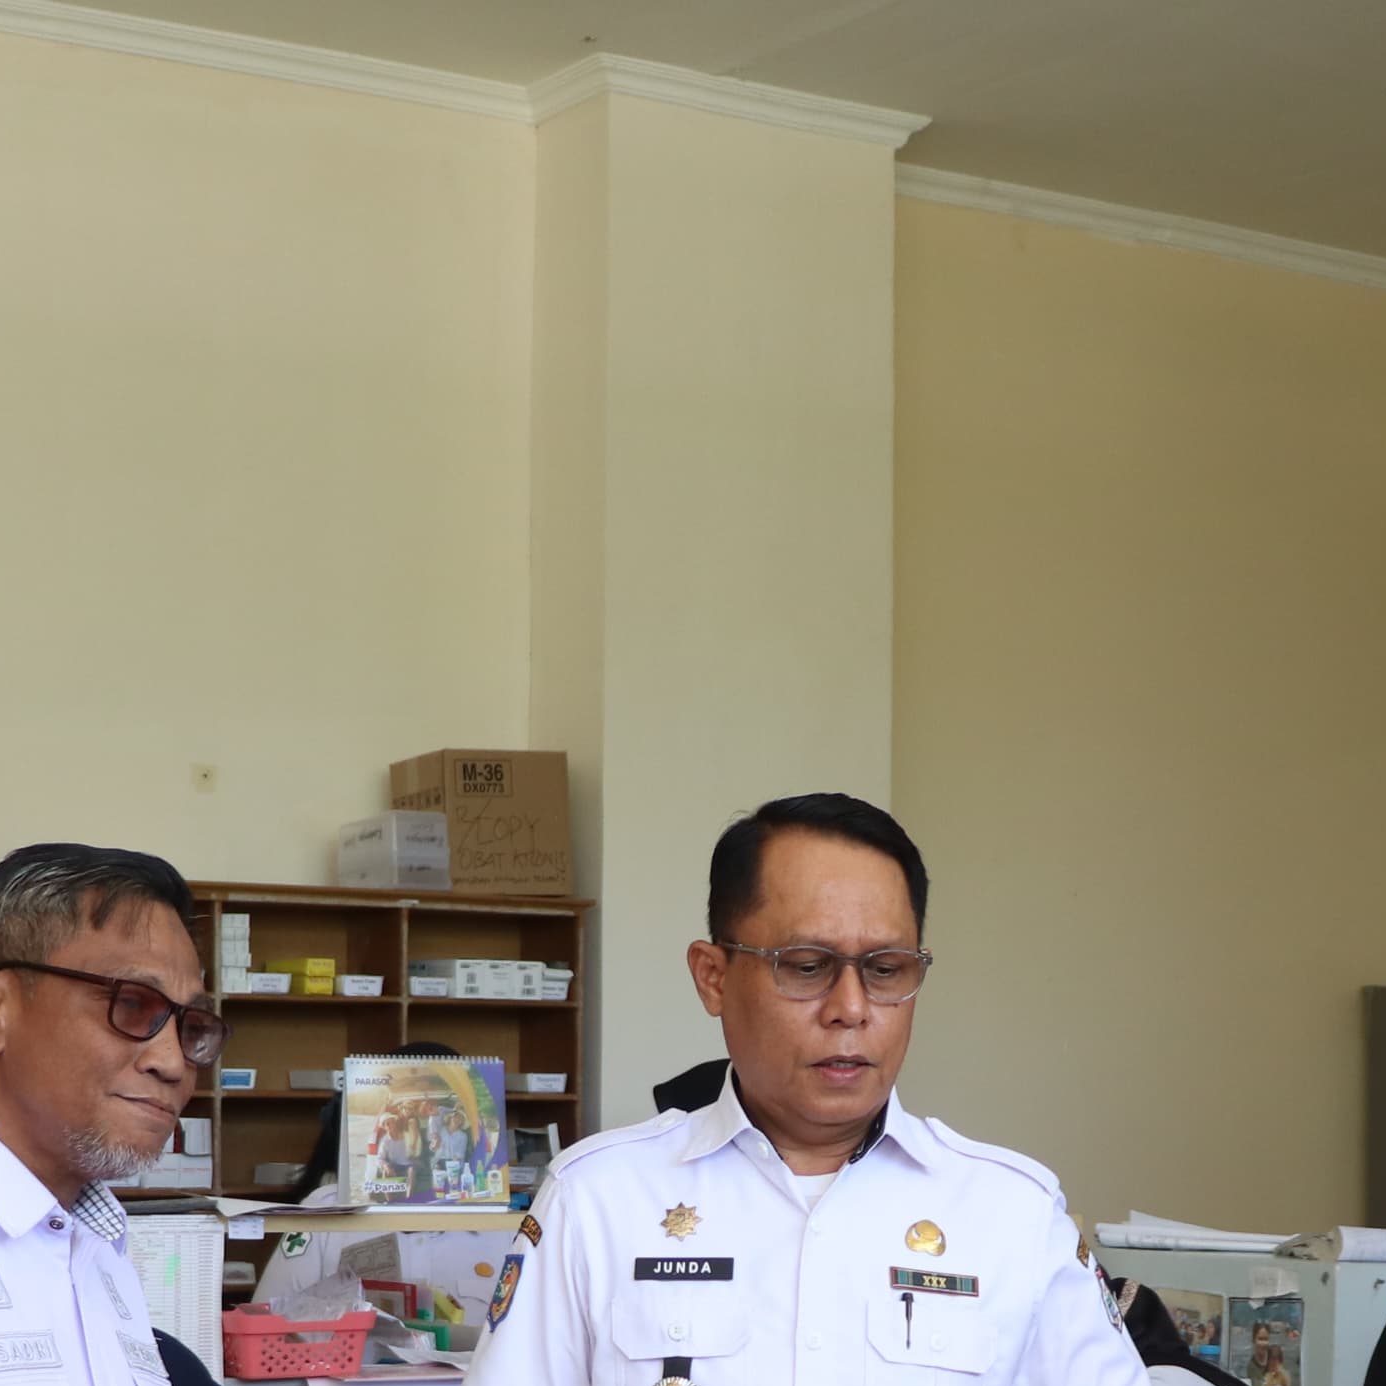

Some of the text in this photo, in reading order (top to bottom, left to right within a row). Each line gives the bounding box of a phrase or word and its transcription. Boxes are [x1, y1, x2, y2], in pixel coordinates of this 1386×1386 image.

[462, 764, 503, 782] M-36
[463, 783, 505, 793] DX0773
[355, 1077, 392, 1086] PARASOL
[653, 1261, 712, 1274] JUNDA
[922, 1275, 947, 1288] XXX
